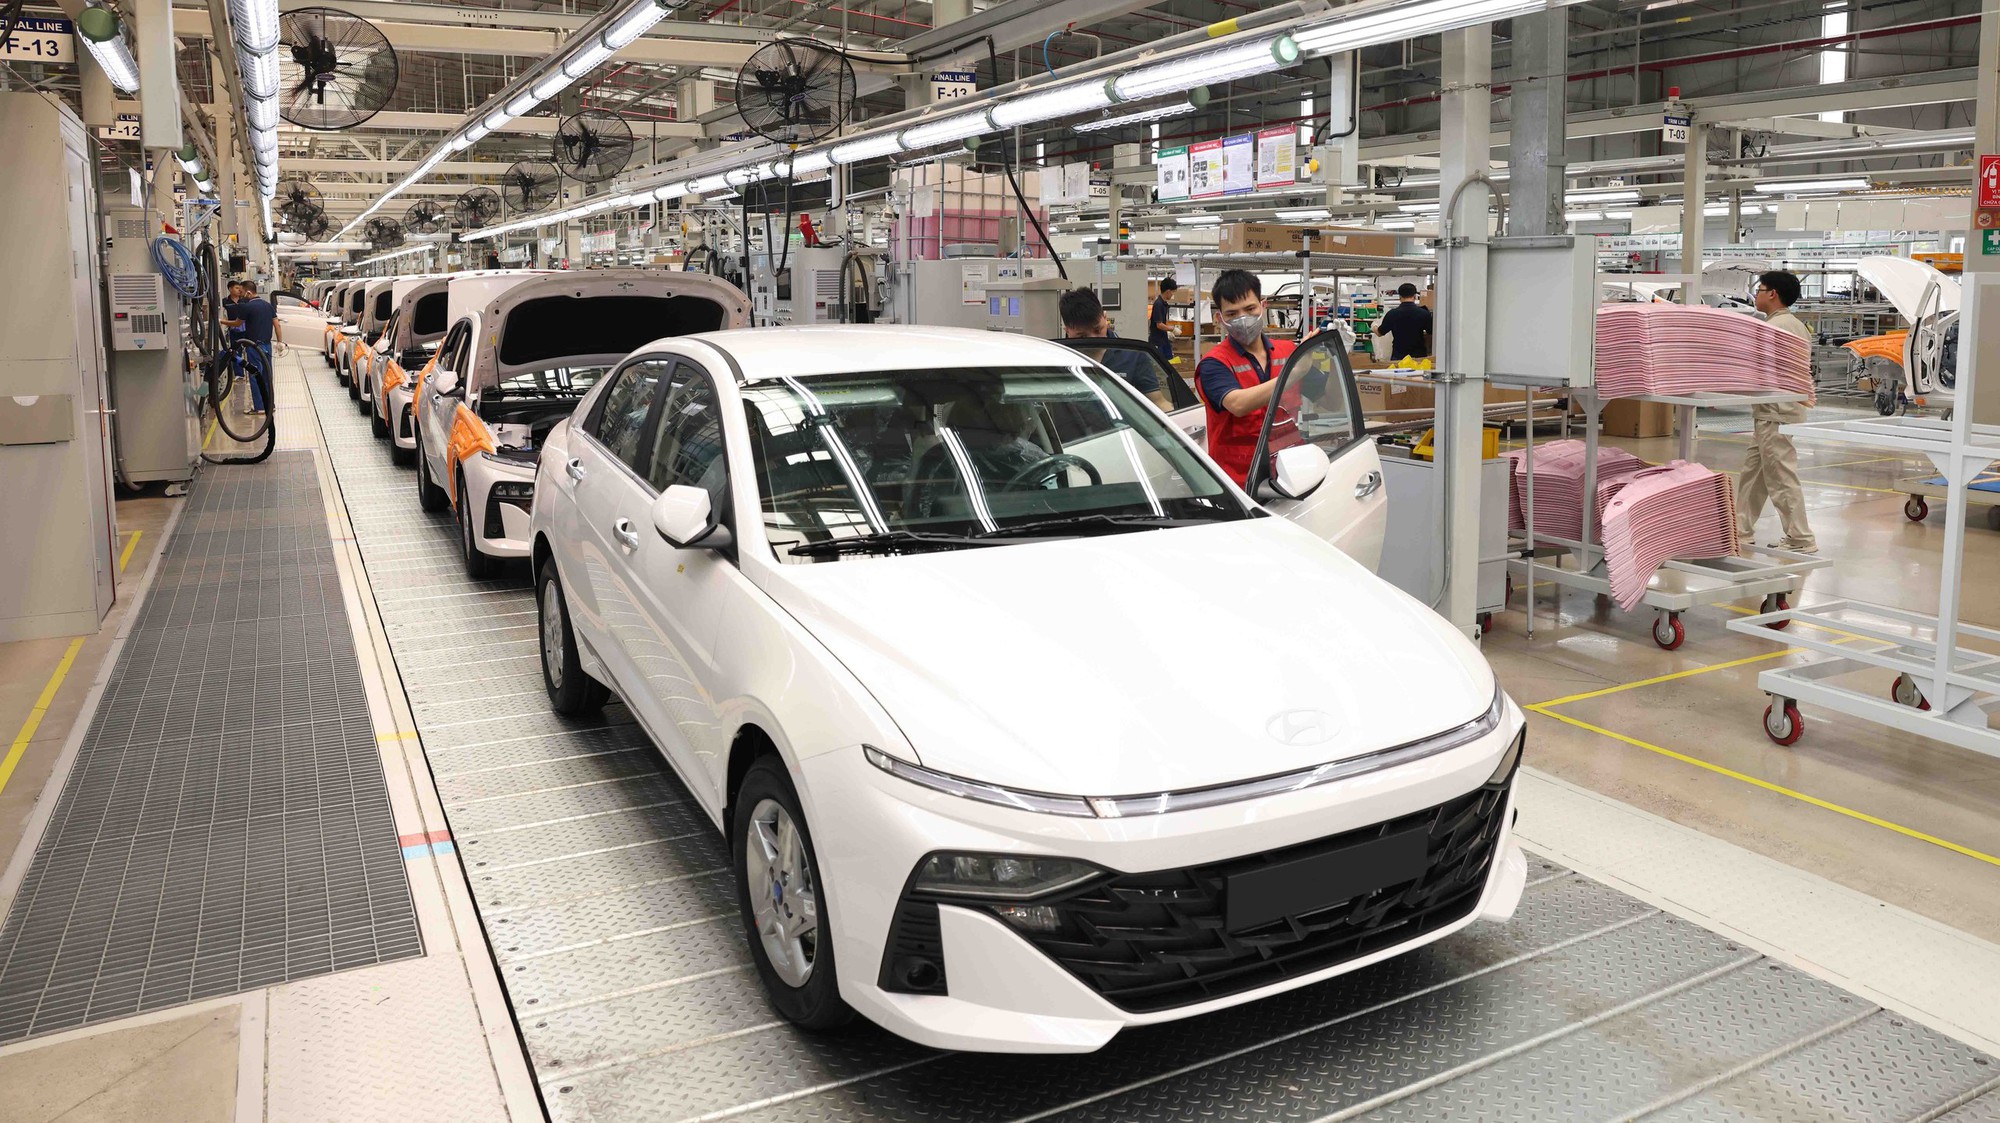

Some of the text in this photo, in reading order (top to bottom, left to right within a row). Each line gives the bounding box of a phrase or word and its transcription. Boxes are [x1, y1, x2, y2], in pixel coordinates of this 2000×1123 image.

[36, 22, 63, 31] LINE
[6, 38, 59, 56] F-13
[108, 126, 140, 136] F-12
[1669, 129, 1685, 140] T-03
[1360, 384, 1382, 392] GLOVIS
